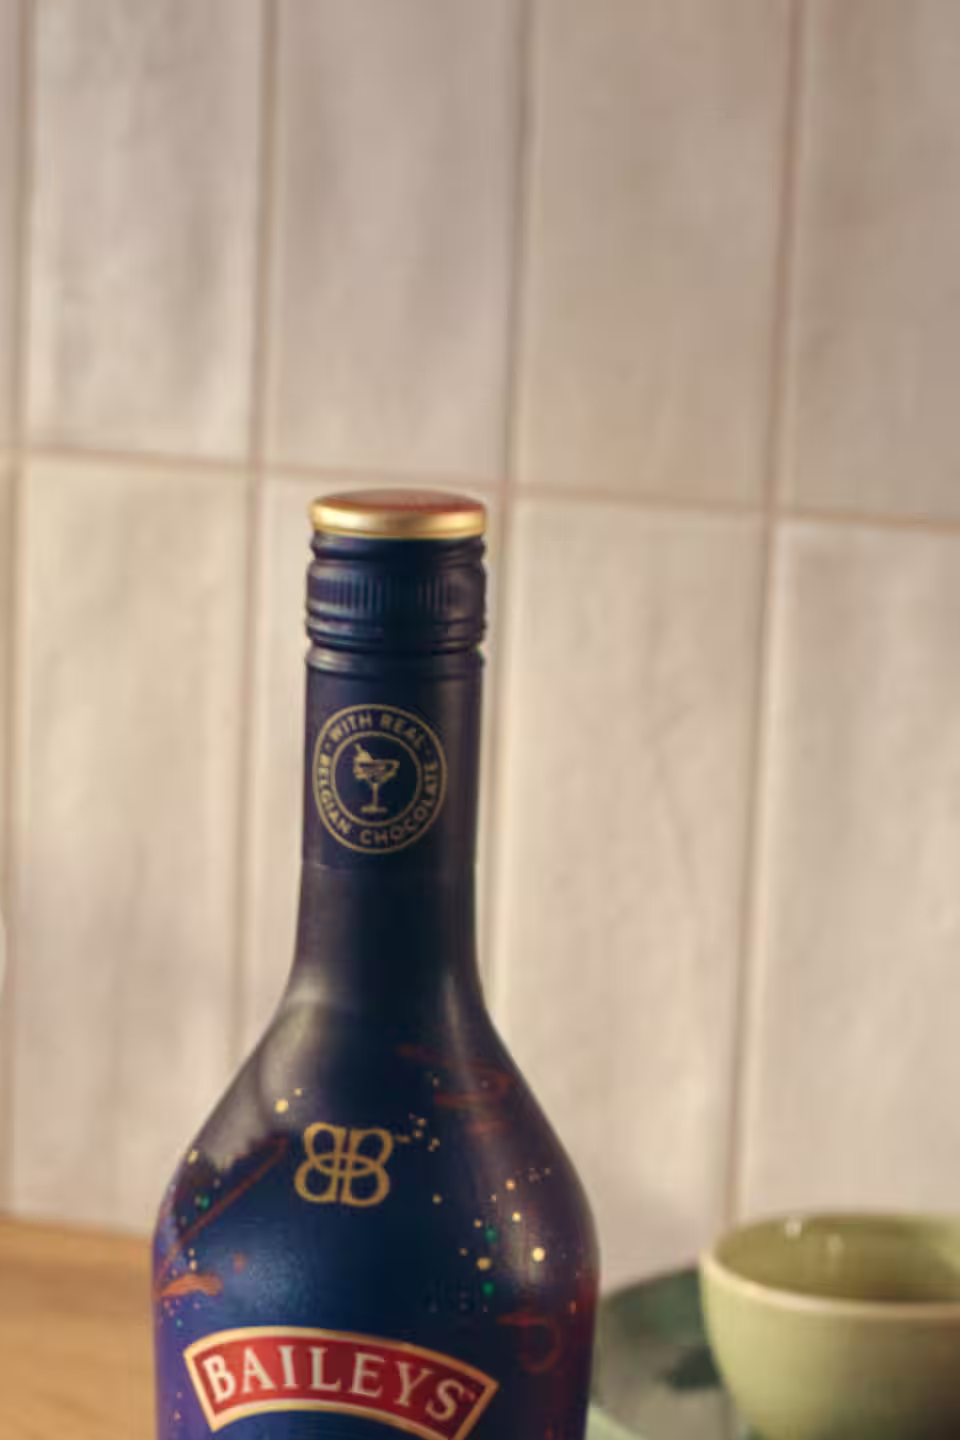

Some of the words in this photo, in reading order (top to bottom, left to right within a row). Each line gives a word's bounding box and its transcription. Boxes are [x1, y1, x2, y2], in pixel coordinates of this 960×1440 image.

[329, 712, 372, 742] WITH
[380, 713, 425, 749] REAL
[201, 1344, 466, 1423] BAILEYS
